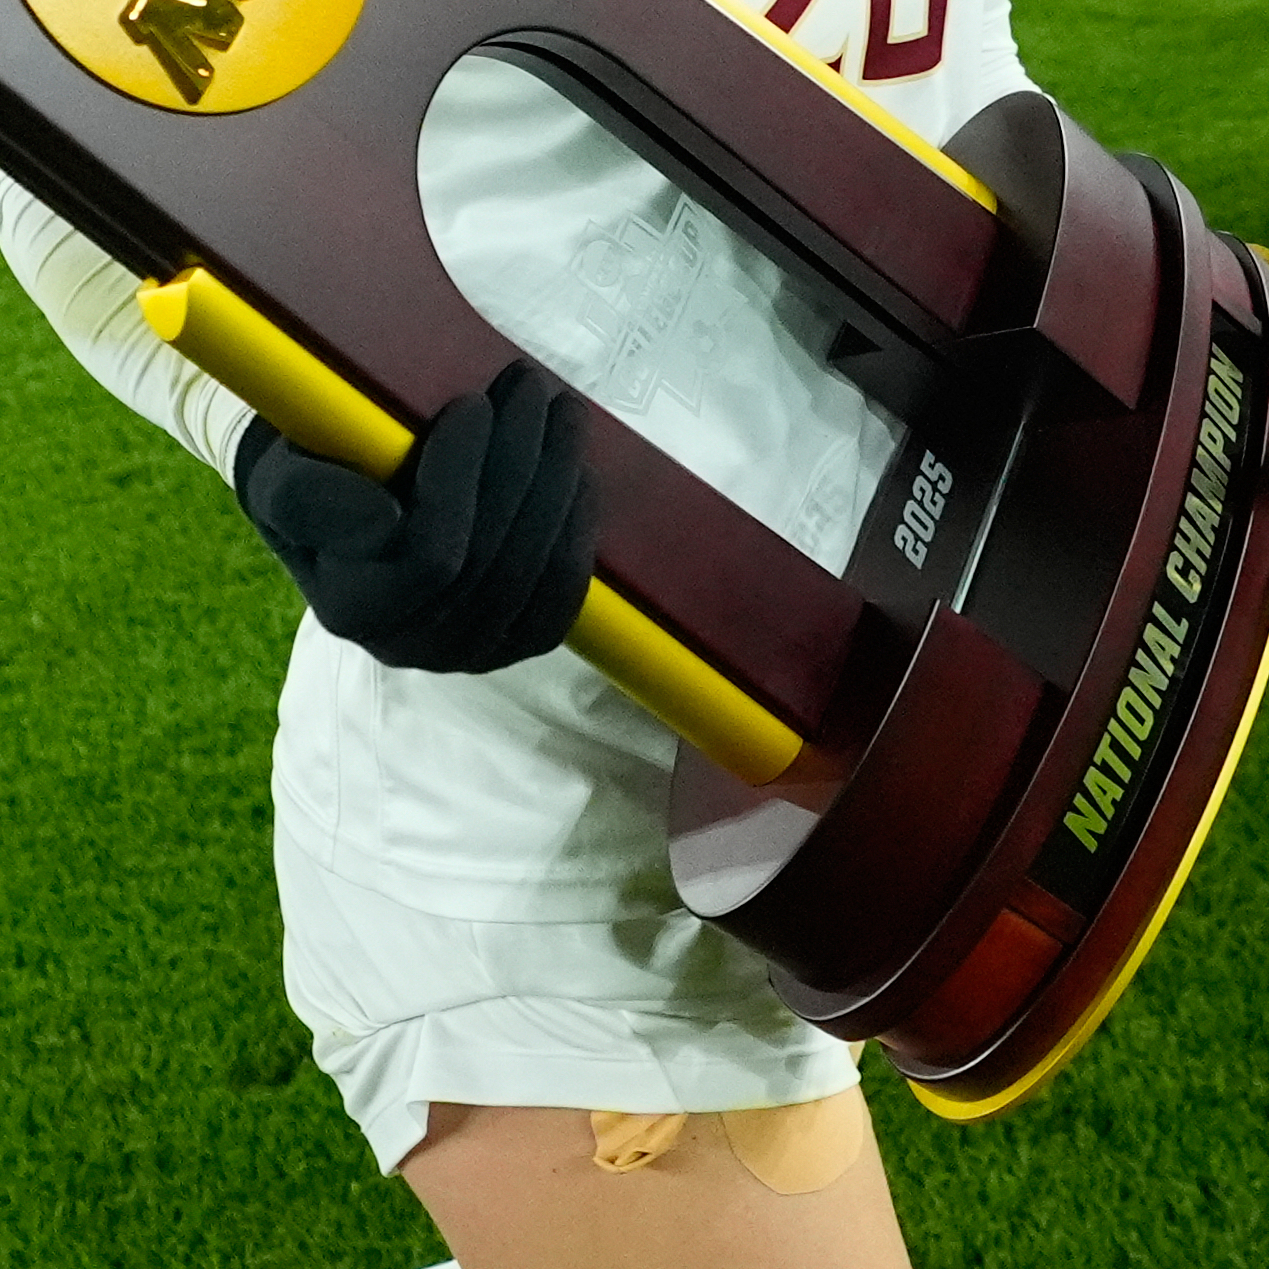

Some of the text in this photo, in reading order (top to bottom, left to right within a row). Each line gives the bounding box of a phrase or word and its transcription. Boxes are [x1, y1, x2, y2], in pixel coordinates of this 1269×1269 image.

[893, 449, 954, 570] 2025
[1062, 342, 1245, 853] NATIONAL CHAMPION
